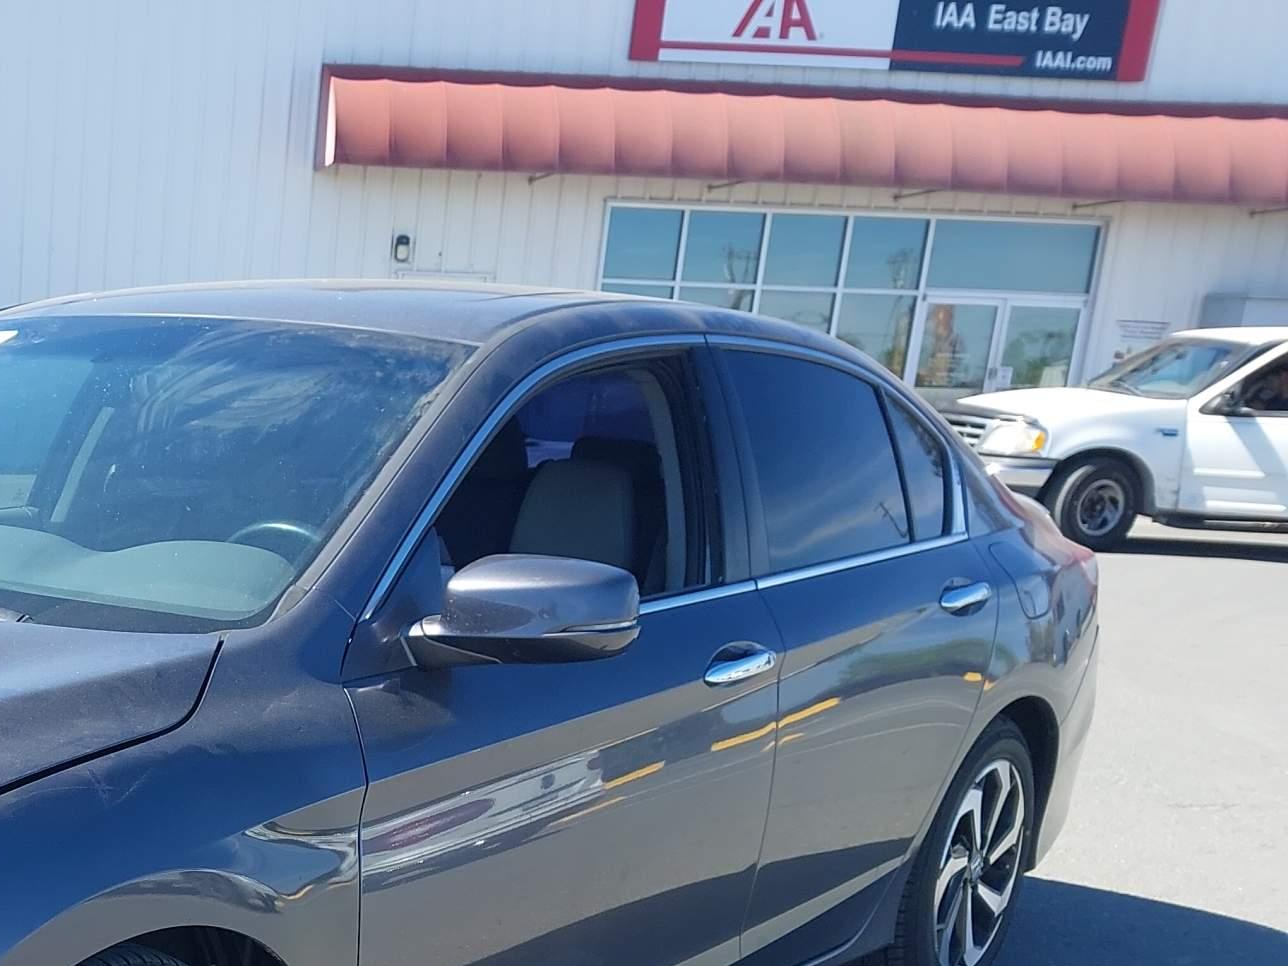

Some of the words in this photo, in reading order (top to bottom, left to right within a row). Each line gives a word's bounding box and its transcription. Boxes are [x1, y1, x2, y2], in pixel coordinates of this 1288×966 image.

[934, 1, 976, 29] IAA
[987, 4, 1040, 32] East
[1043, 6, 1090, 41] Bay
[1034, 50, 1112, 71] IAAI.com
